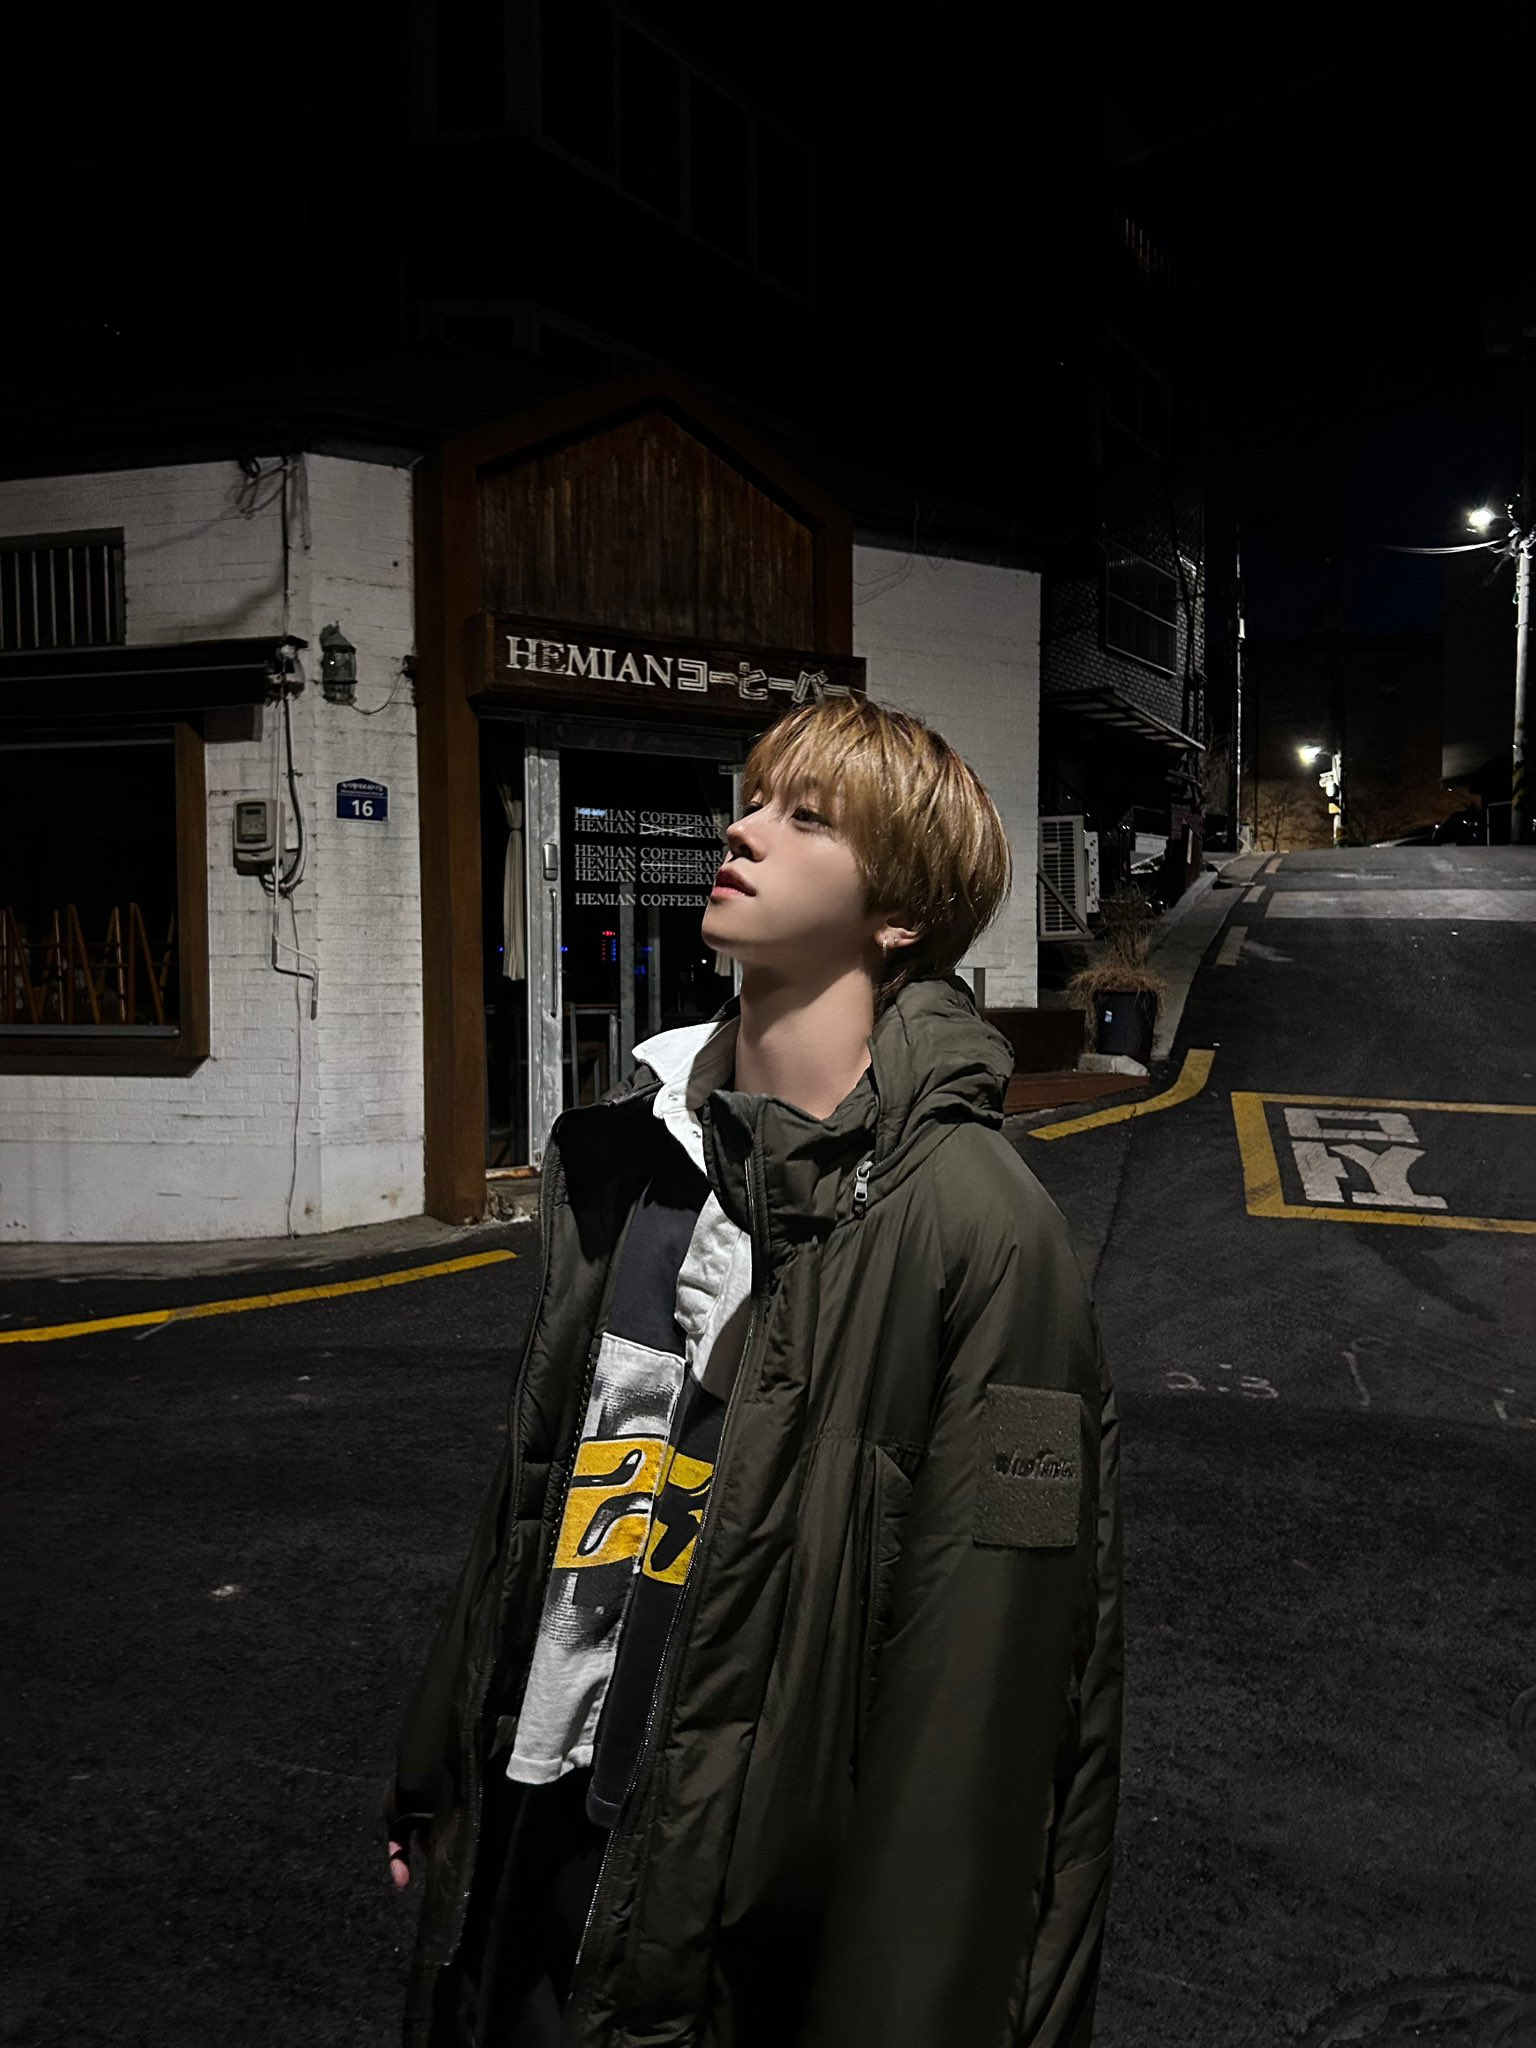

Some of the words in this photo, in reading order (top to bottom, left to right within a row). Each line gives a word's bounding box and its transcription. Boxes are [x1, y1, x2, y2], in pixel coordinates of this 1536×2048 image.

[505, 635, 671, 689] HEMIAN
[352, 799, 374, 817] 16
[574, 806, 636, 822] HEMIAN
[639, 811, 723, 828] COFFEEBAR
[574, 819, 636, 835] HEMIAN
[574, 844, 637, 859] HEMIAN
[640, 847, 723, 862] COFFEEBAR
[574, 856, 637, 871] HEMIAN
[574, 869, 637, 883] HEMIAN
[640, 871, 715, 886] COFFEEBA
[575, 892, 637, 907] HEMIAN
